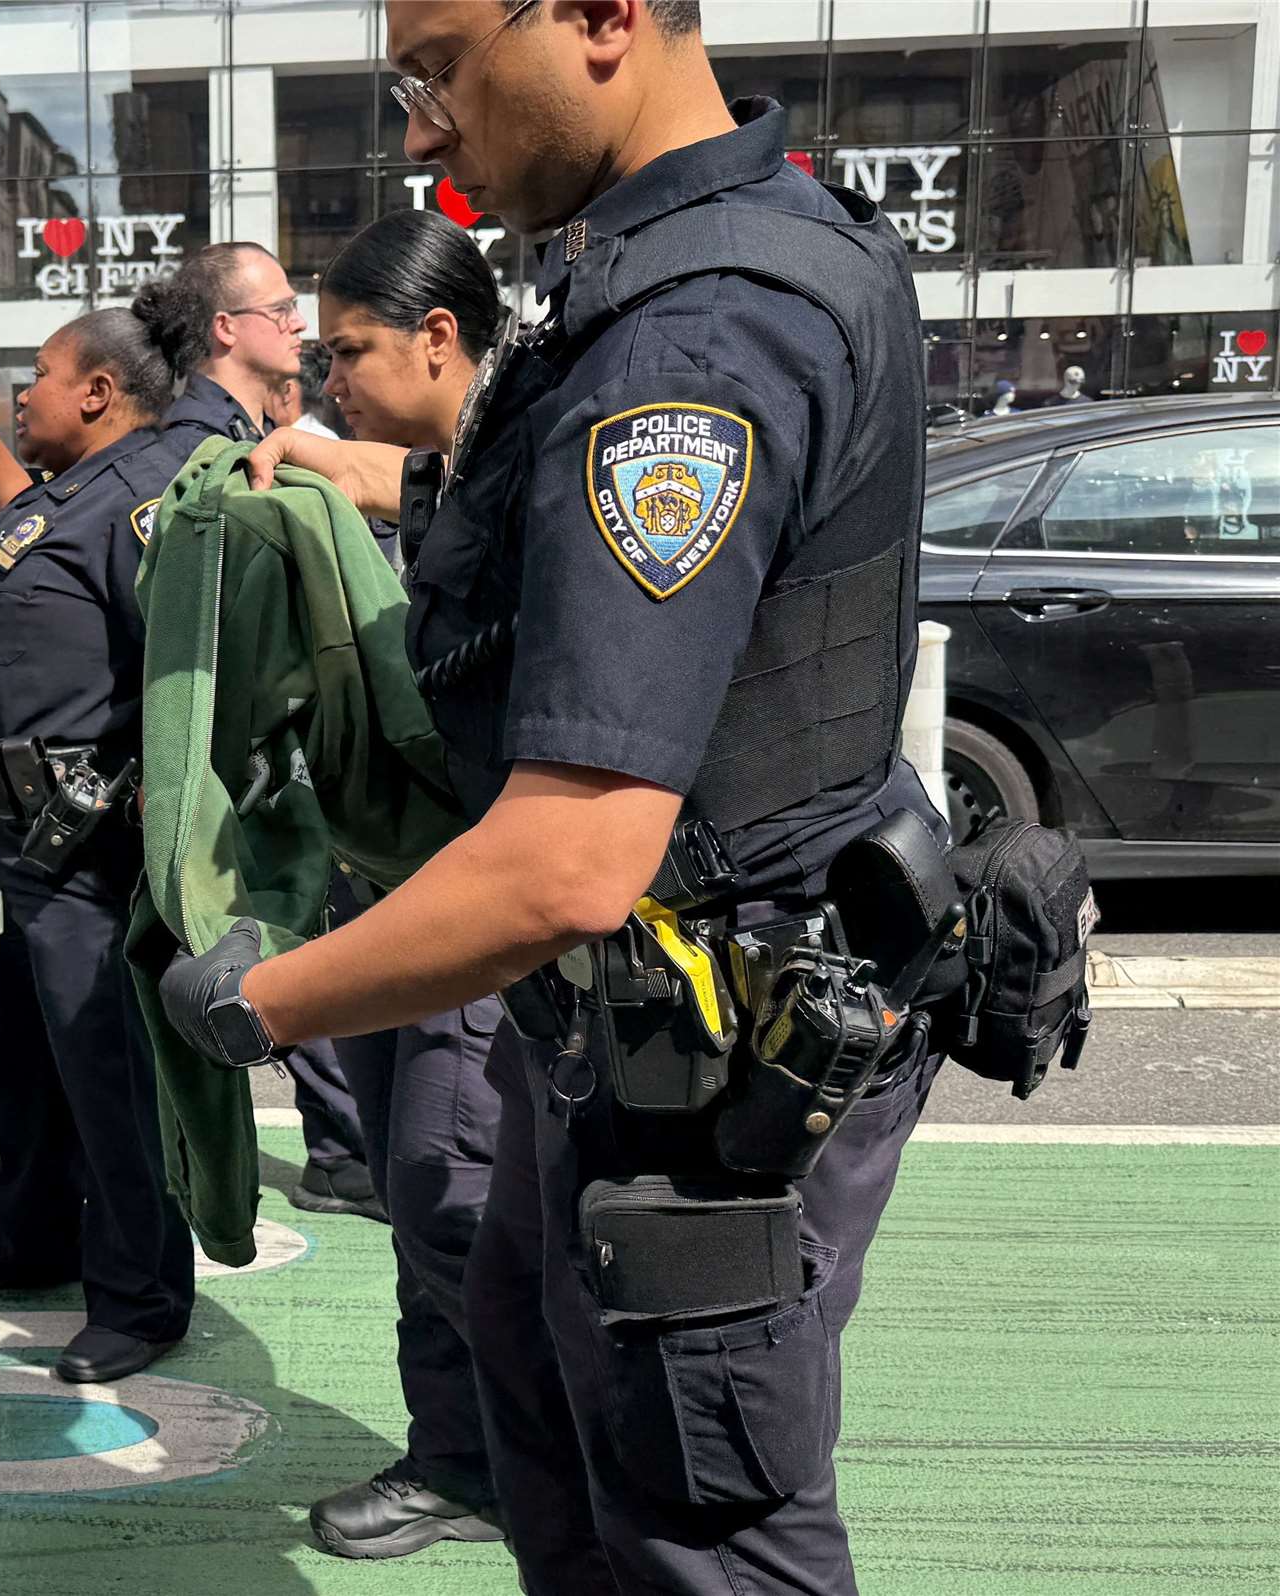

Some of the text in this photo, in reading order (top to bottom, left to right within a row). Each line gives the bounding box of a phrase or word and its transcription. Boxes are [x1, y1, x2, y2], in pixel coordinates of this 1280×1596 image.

[16, 217, 41, 259] I
[1219, 330, 1236, 356] I
[631, 414, 712, 438] POLICE
[601, 433, 739, 467] DEPARTMENT
[598, 488, 648, 563] CITY OF
[675, 479, 741, 575] NEW YORK
